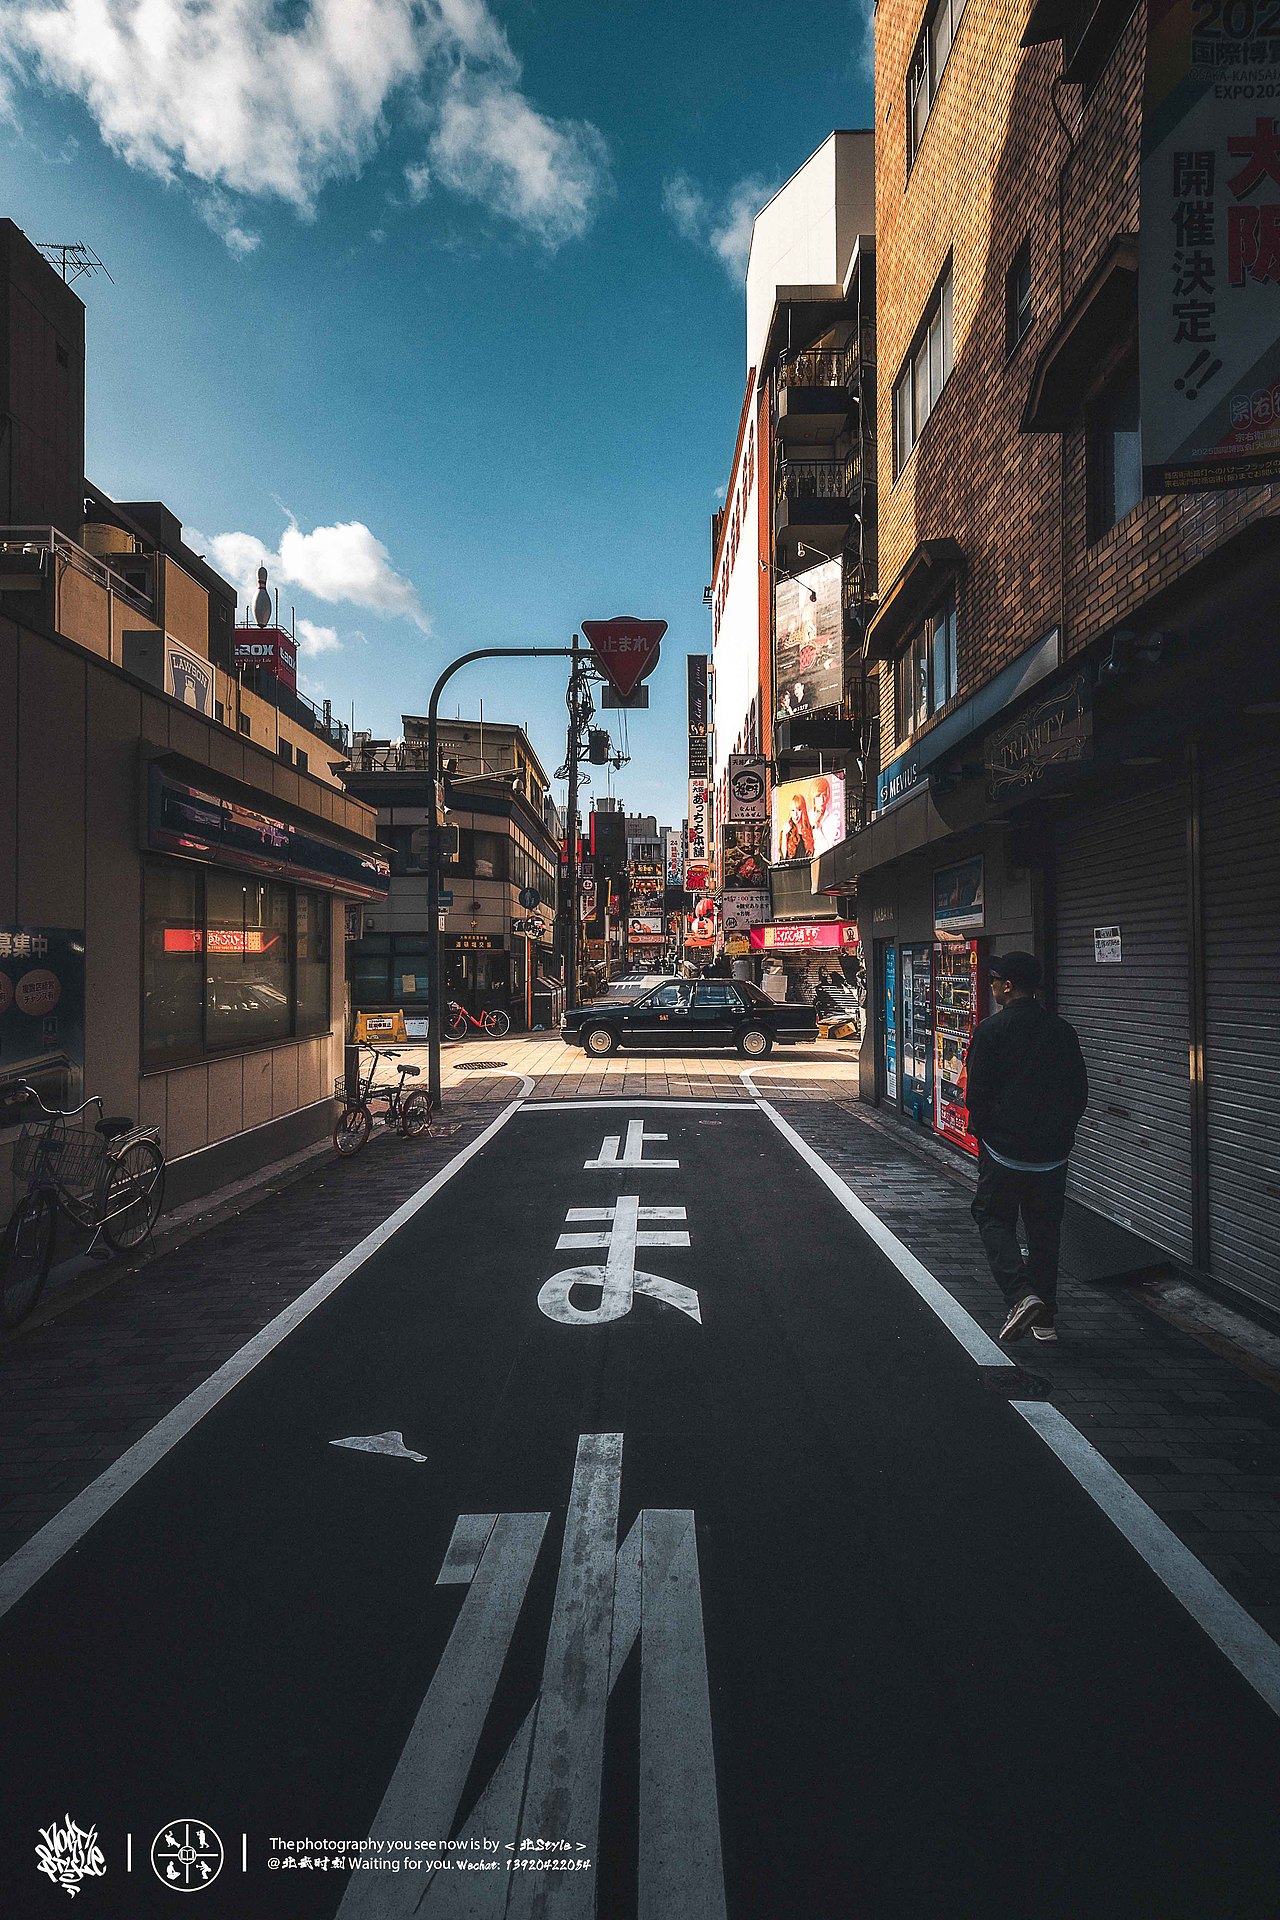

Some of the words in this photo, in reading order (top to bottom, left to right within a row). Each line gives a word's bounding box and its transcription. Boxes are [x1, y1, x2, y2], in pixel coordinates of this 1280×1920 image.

[601, 636, 649, 652] 止まれ
[172, 655, 209, 689] LAWSON
[1001, 710, 1065, 768] TRINITY
[889, 763, 918, 799] MEVIUS
[692, 793, 705, 858] あっちち本舗
